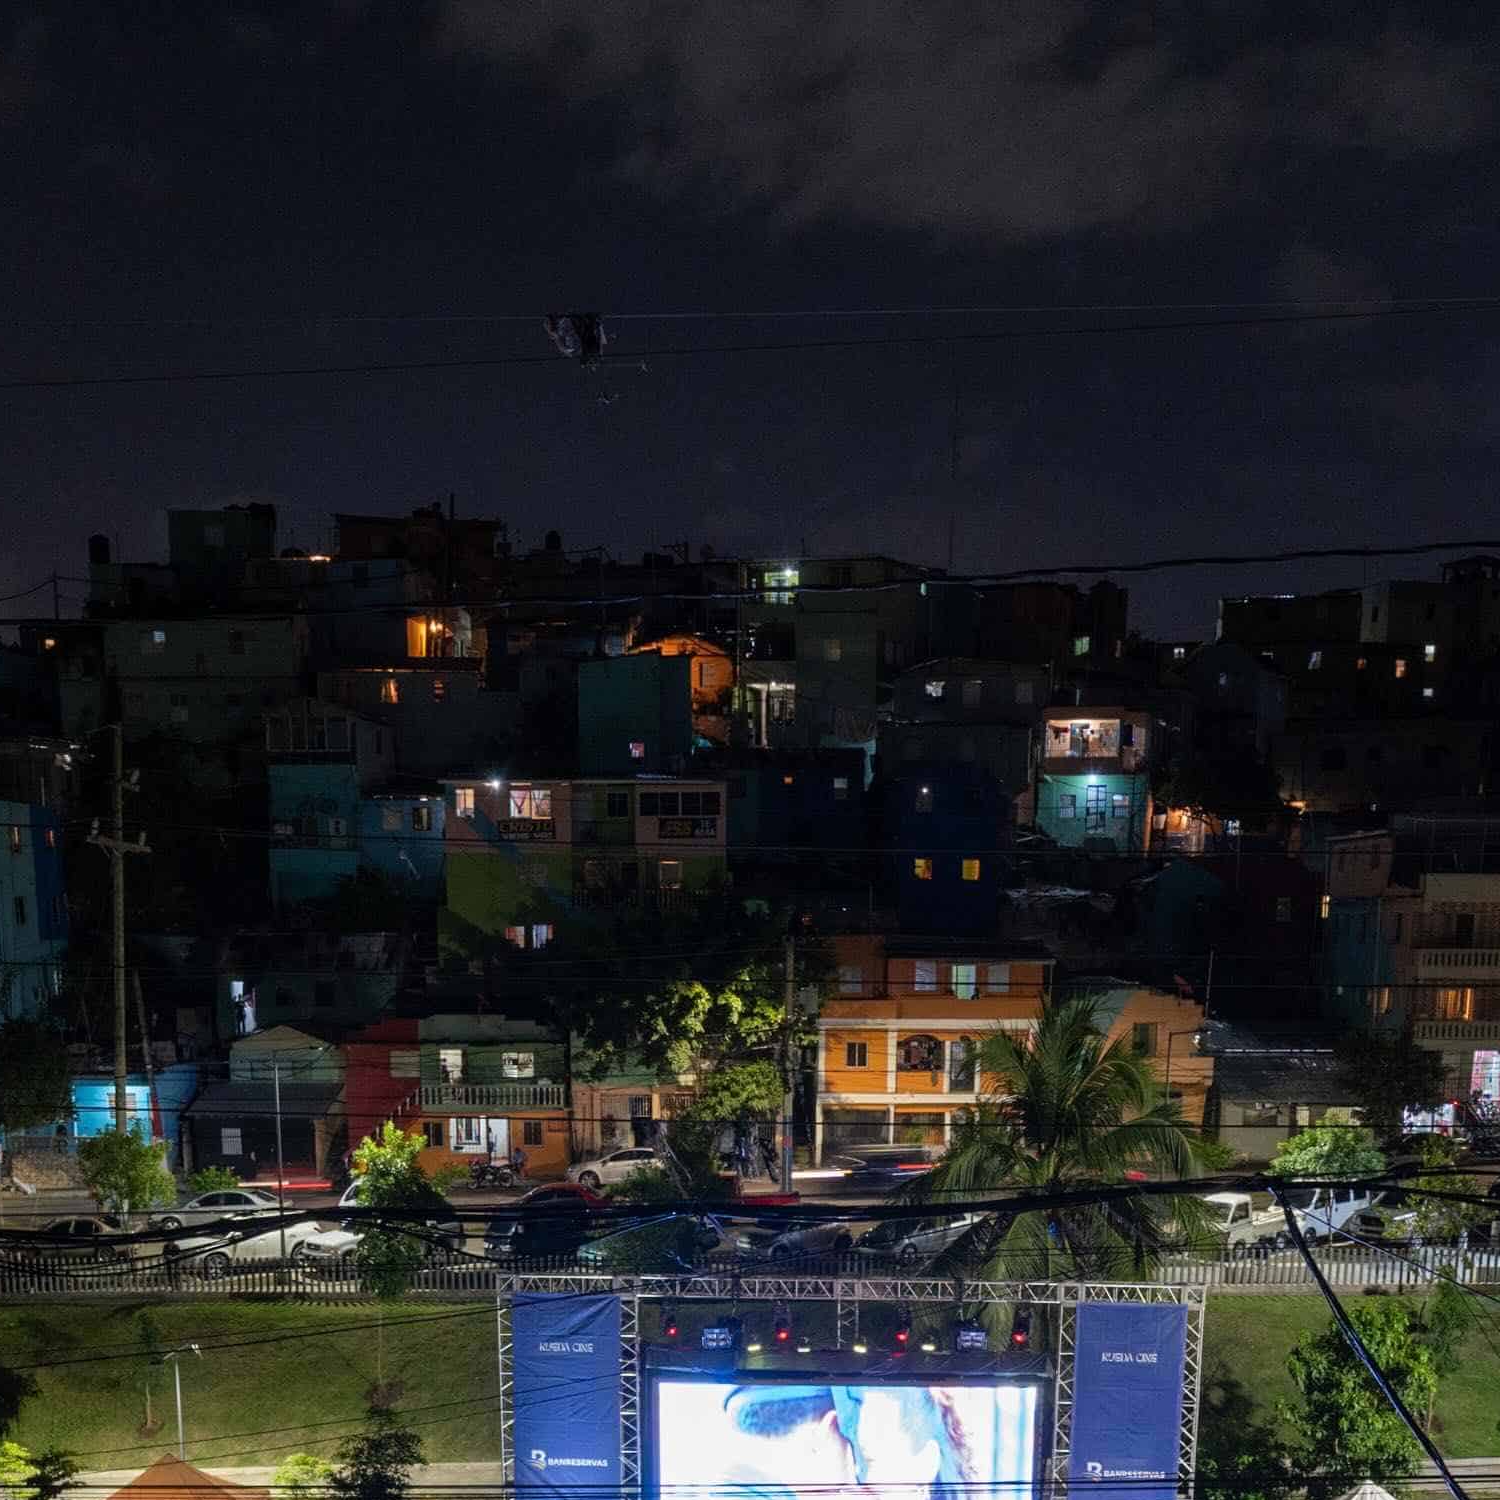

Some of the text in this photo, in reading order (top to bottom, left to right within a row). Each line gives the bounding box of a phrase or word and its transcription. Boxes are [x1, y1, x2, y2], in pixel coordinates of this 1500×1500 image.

[572, 1343, 594, 1353] CINE
[1136, 1353, 1157, 1363] CINE
[547, 1458, 608, 1467] BANRESERVAS
